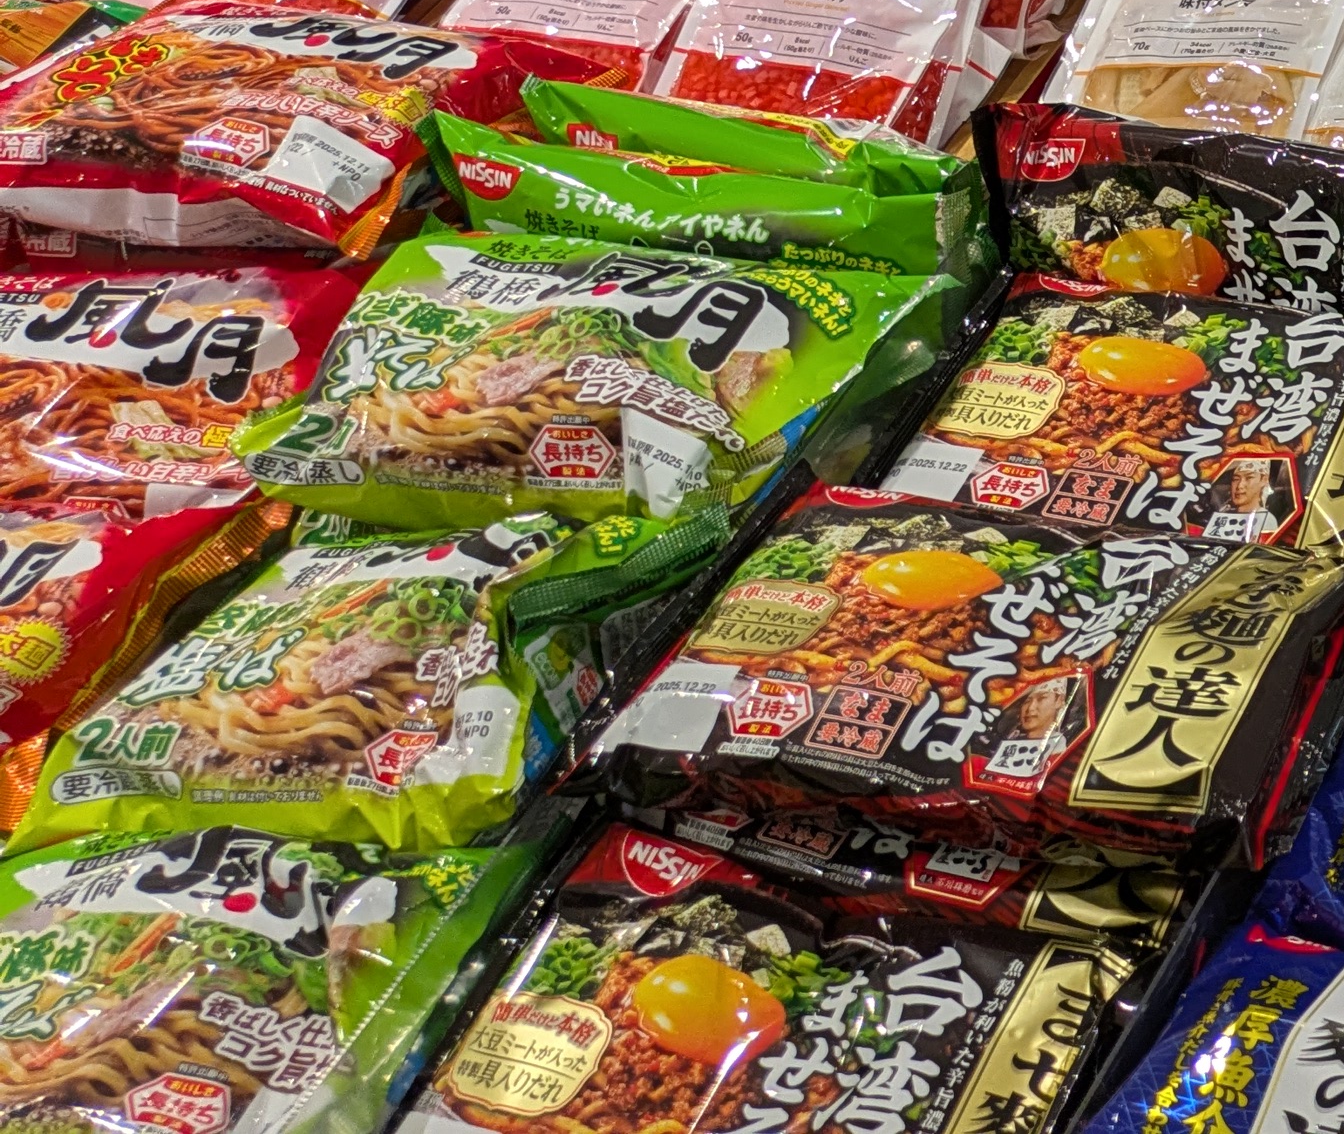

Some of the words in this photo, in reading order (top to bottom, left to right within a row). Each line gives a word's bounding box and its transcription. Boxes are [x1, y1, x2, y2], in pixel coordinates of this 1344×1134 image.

[1132, 42, 1150, 51] 70g
[476, 255, 555, 273] FUGETSU
[540, 439, 608, 466] 長持ち
[908, 458, 968, 473] 2025.12.22
[976, 474, 1043, 497] 長持ち
[654, 680, 718, 695] 2025.12.22
[468, 1026, 588, 1071] 大豆ミートが入った
